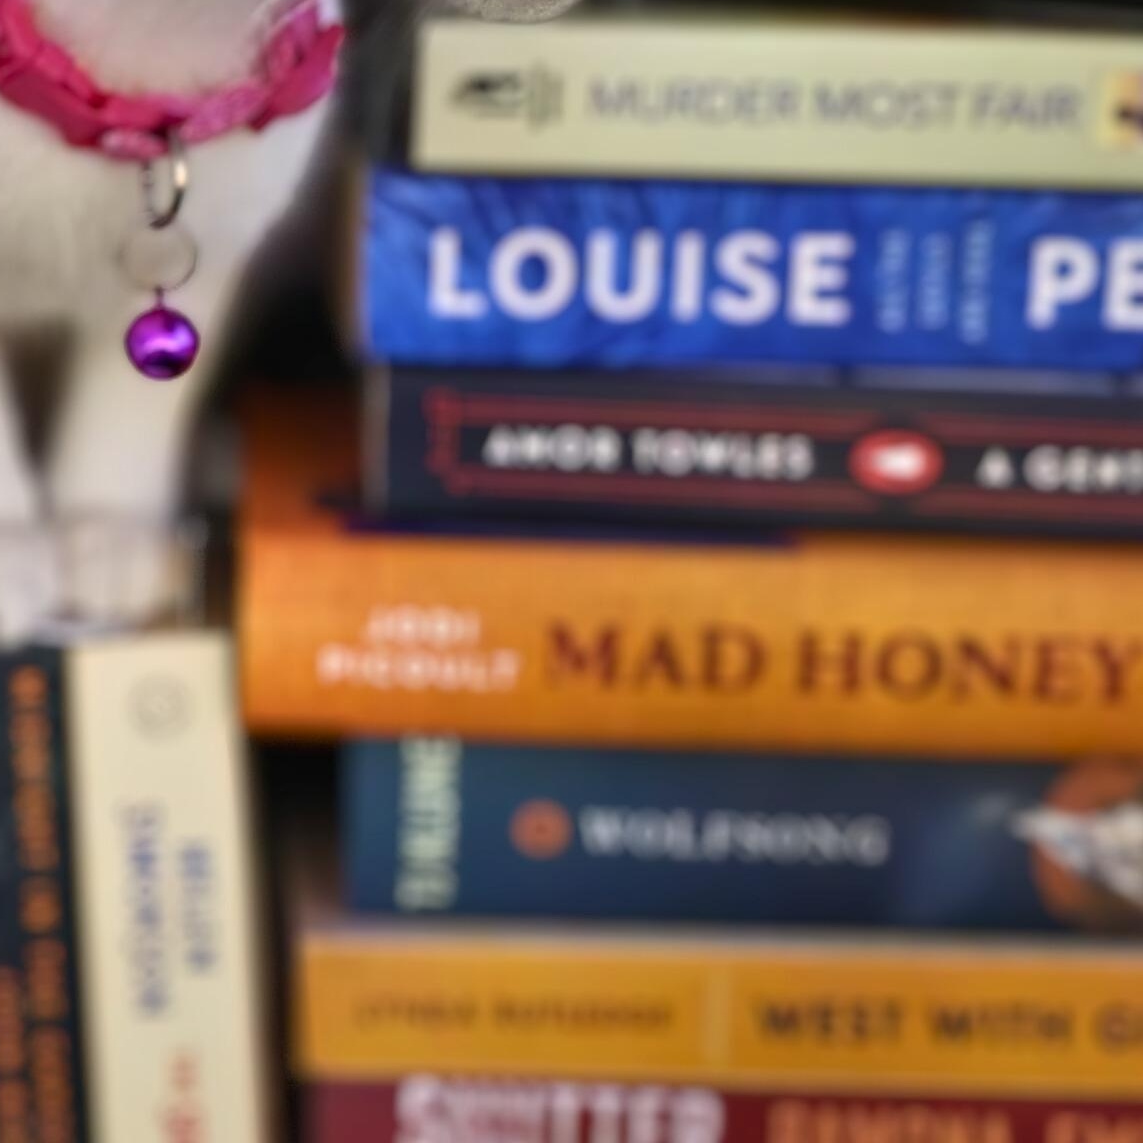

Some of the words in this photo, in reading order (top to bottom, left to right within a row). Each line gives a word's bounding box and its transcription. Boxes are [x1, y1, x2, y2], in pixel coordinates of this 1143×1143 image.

[586, 78, 801, 126] MURDER
[816, 81, 959, 128] MOST
[970, 83, 1086, 131] FAIR
[425, 226, 858, 328] LOUISE
[482, 424, 622, 473] AMOR
[632, 430, 816, 482] TOWLES
[546, 620, 773, 695] MAD
[797, 631, 1143, 708] HONEY
[580, 803, 891, 867] WOLFSONG
[755, 999, 904, 1050] WEST
[932, 1002, 1074, 1053] WITH
